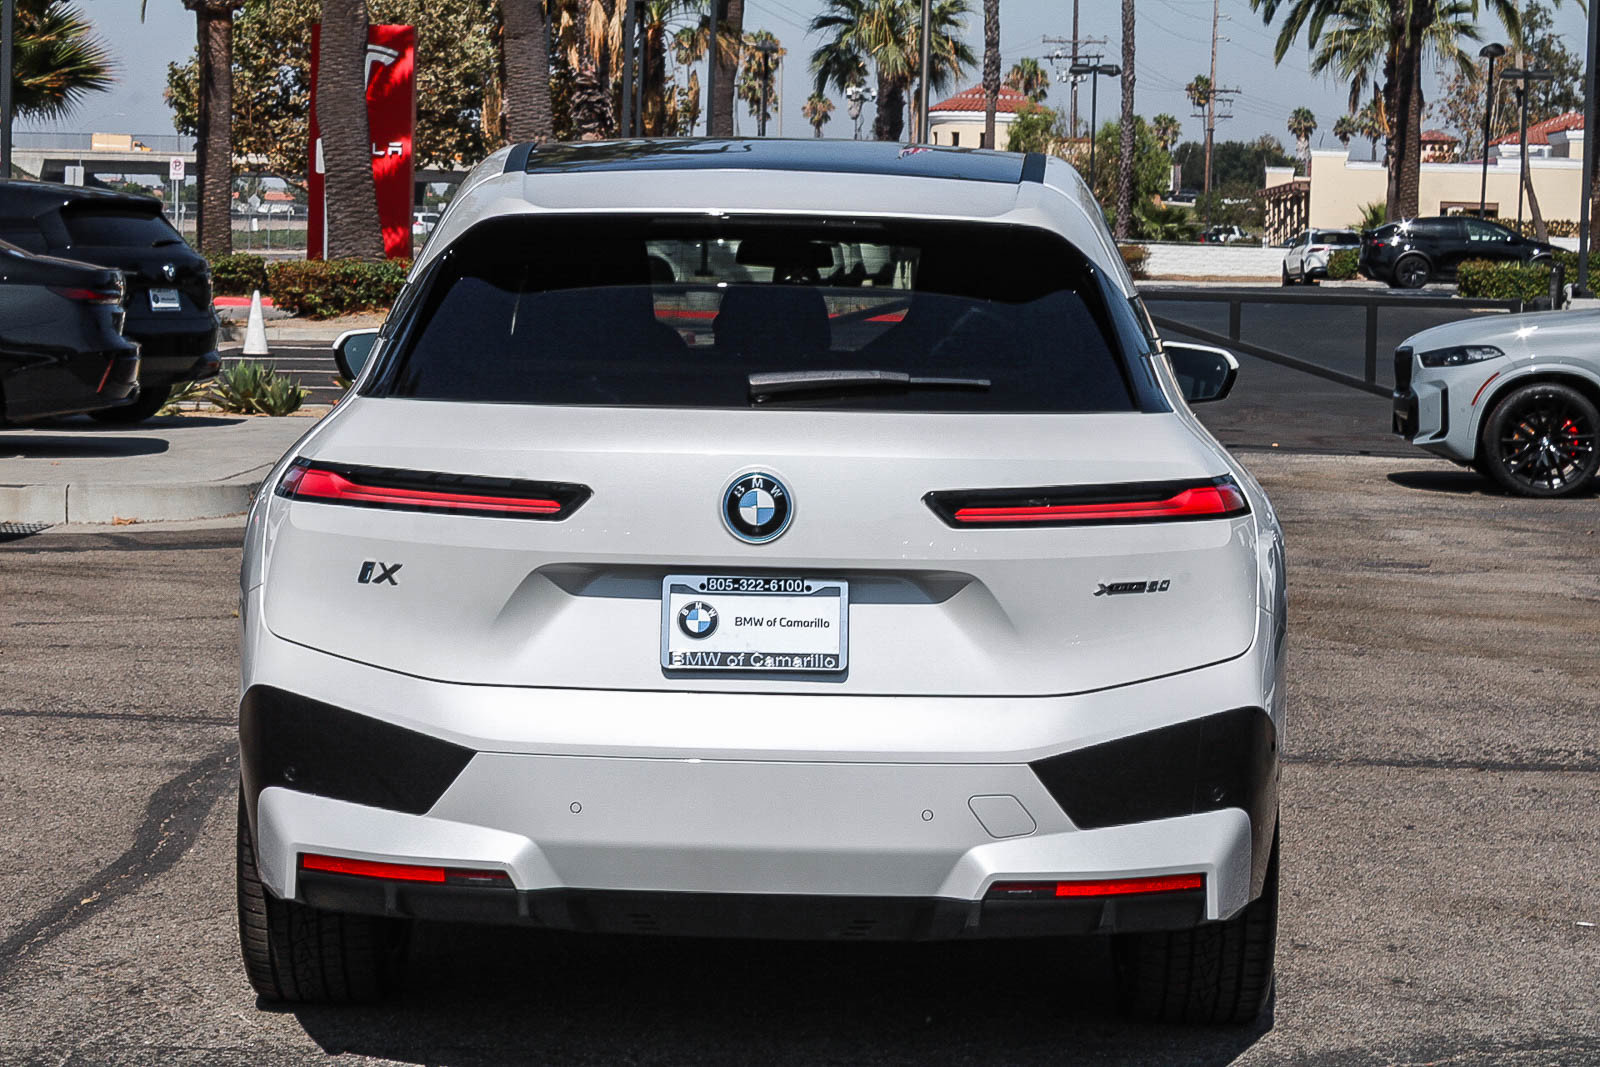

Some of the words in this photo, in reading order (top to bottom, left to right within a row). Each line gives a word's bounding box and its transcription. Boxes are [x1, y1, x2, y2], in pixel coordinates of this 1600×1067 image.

[734, 477, 783, 498] BMW
[708, 578, 803, 592] 805-322-6100
[681, 602, 717, 618] BMW
[734, 616, 763, 627] BMW
[766, 616, 778, 628] of
[779, 616, 830, 629] Camarillo
[671, 652, 721, 666] BMW
[727, 652, 745, 667] of
[750, 652, 836, 668] Camarillo
